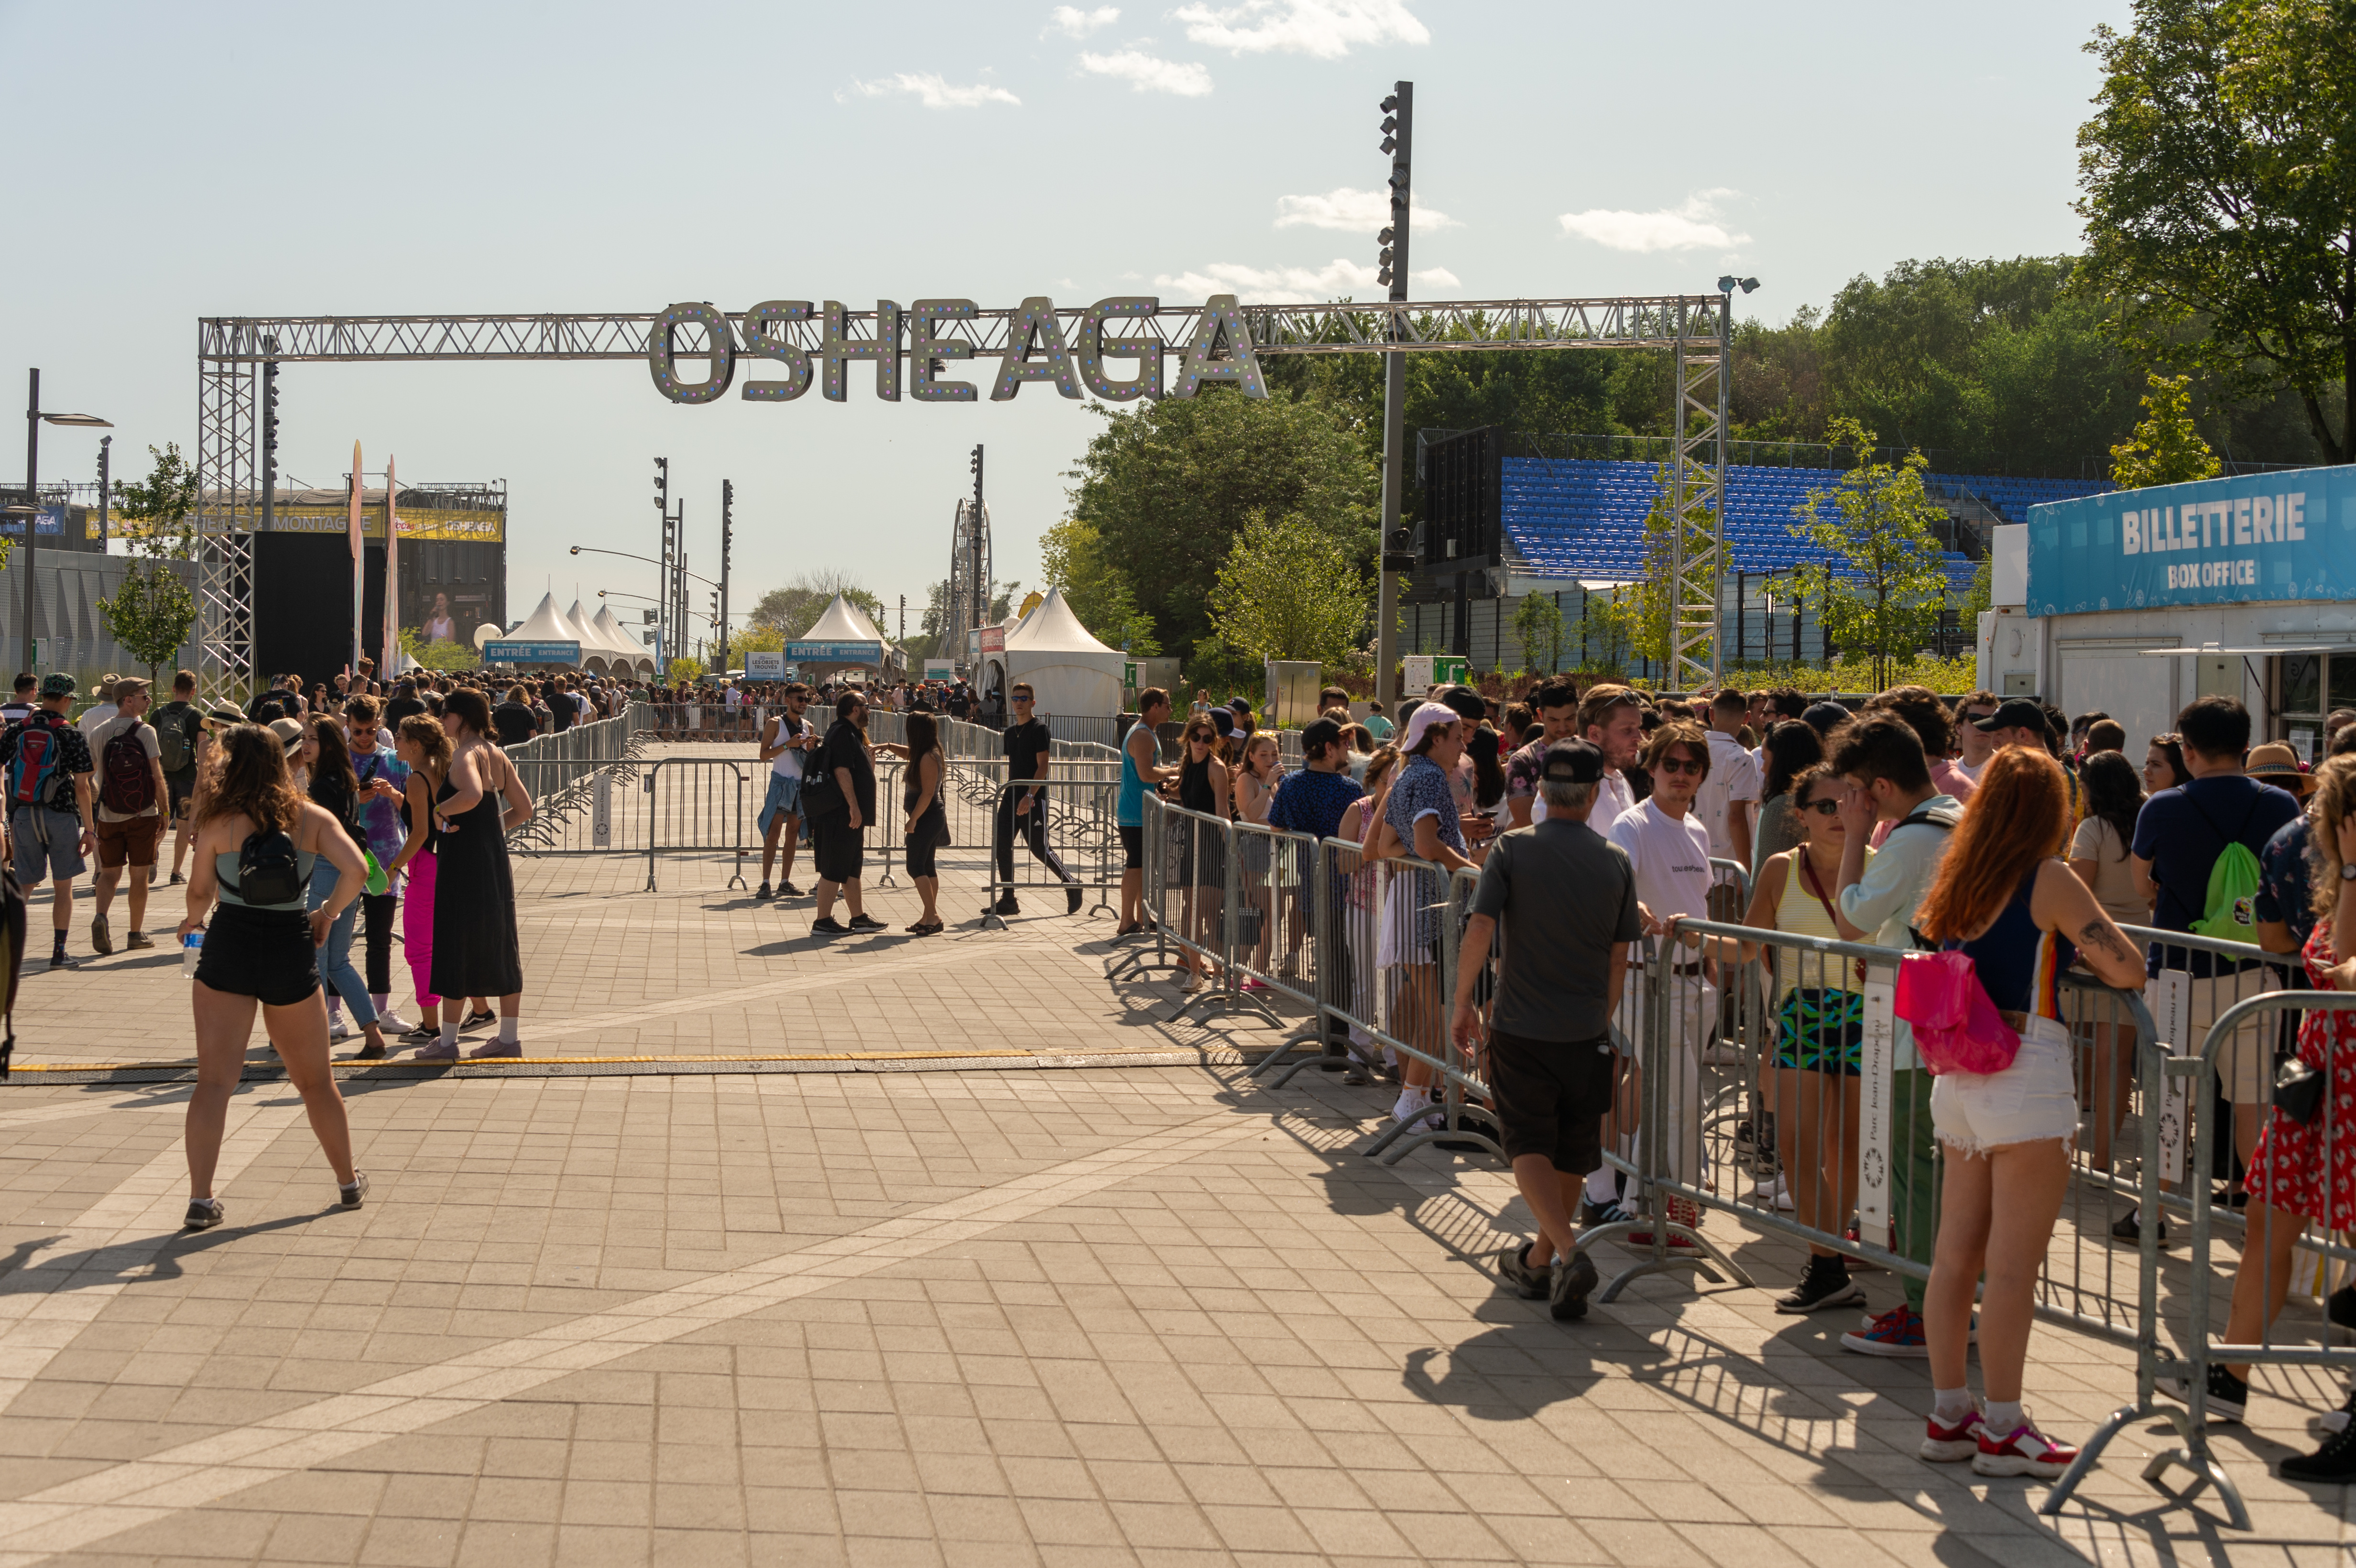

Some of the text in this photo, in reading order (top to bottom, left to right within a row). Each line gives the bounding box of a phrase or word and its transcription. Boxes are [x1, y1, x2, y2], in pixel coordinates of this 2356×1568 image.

[649, 294, 1269, 404] OSHEAGA
[273, 516, 372, 531] MONTAGE
[446, 521, 496, 532] OSHEAGA
[2122, 492, 2305, 555] BILLETTERIE
[2168, 559, 2255, 589] BOX OFFICE
[491, 646, 531, 657] ENTRÉE
[791, 645, 832, 656] ENTRÉE
[1871, 1020, 1880, 1108] Jean-Drapeau
